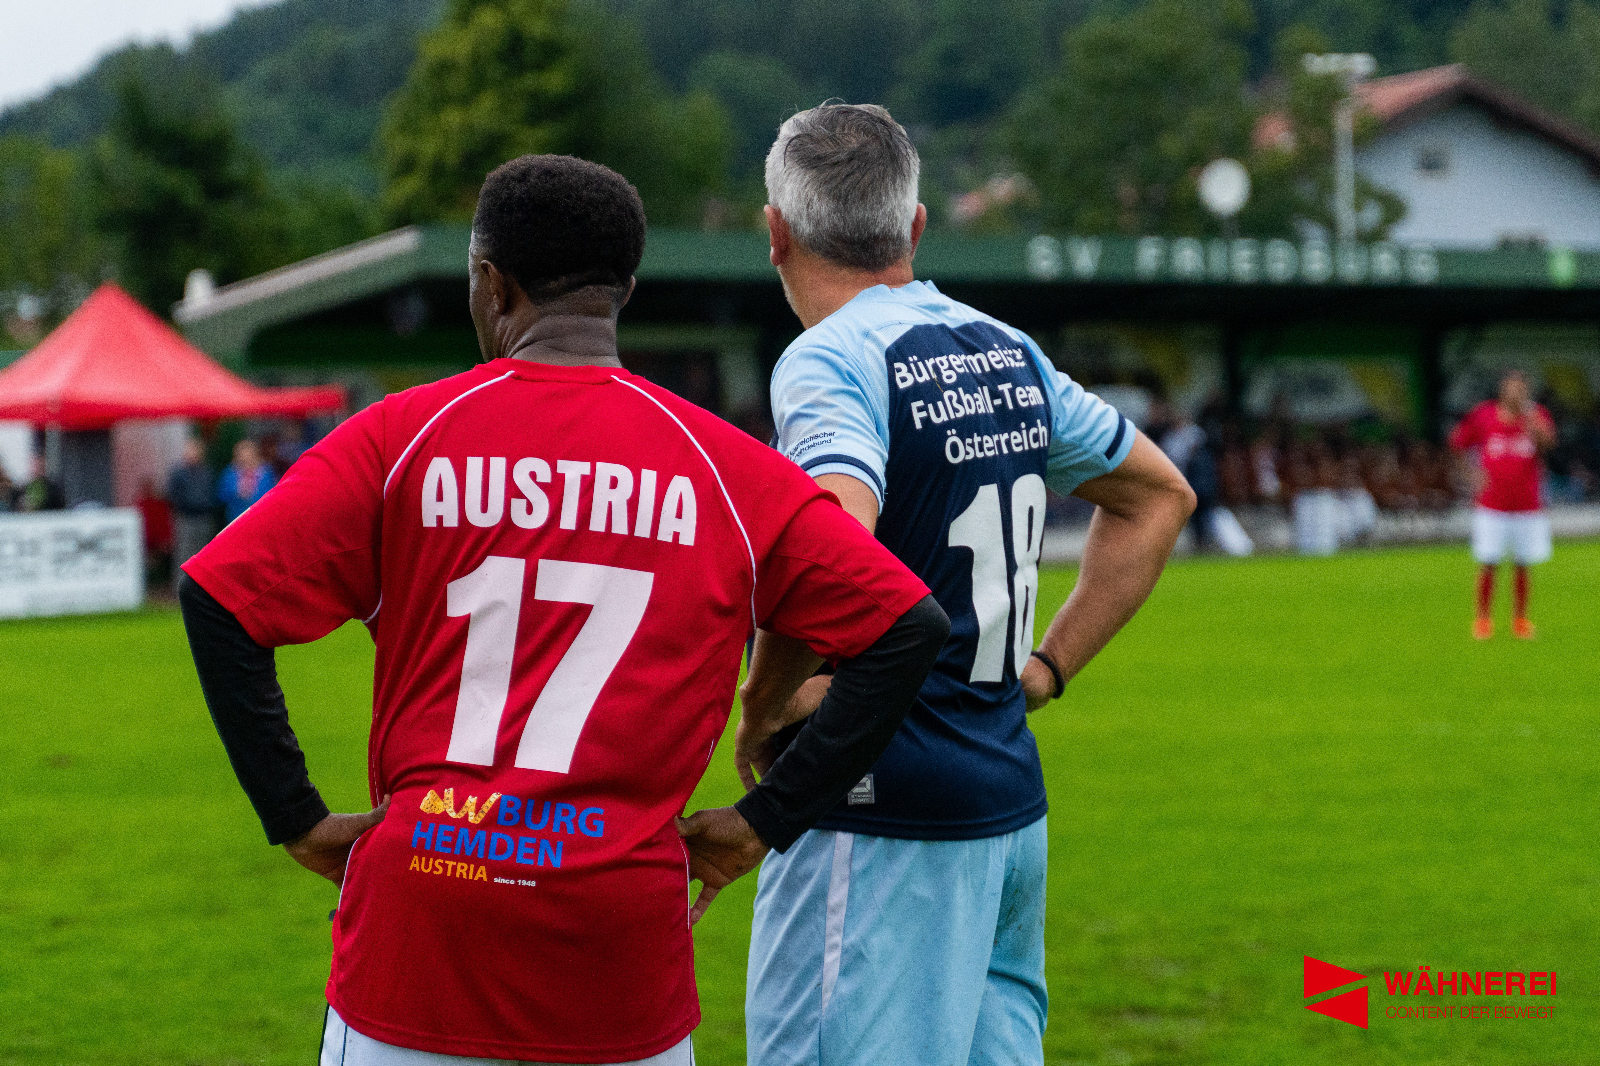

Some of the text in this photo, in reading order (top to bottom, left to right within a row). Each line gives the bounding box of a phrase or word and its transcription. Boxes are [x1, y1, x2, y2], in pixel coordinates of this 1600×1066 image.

[910, 382, 1045, 430] Fußball-Team
[945, 418, 1048, 464] Österreich
[421, 456, 697, 546] AUSTRIA
[948, 473, 1047, 683] 18
[445, 555, 655, 774] 17
[411, 820, 564, 868] HEMDEN
[409, 855, 488, 882] AUSTRIA
[493, 876, 536, 887] since 1948
